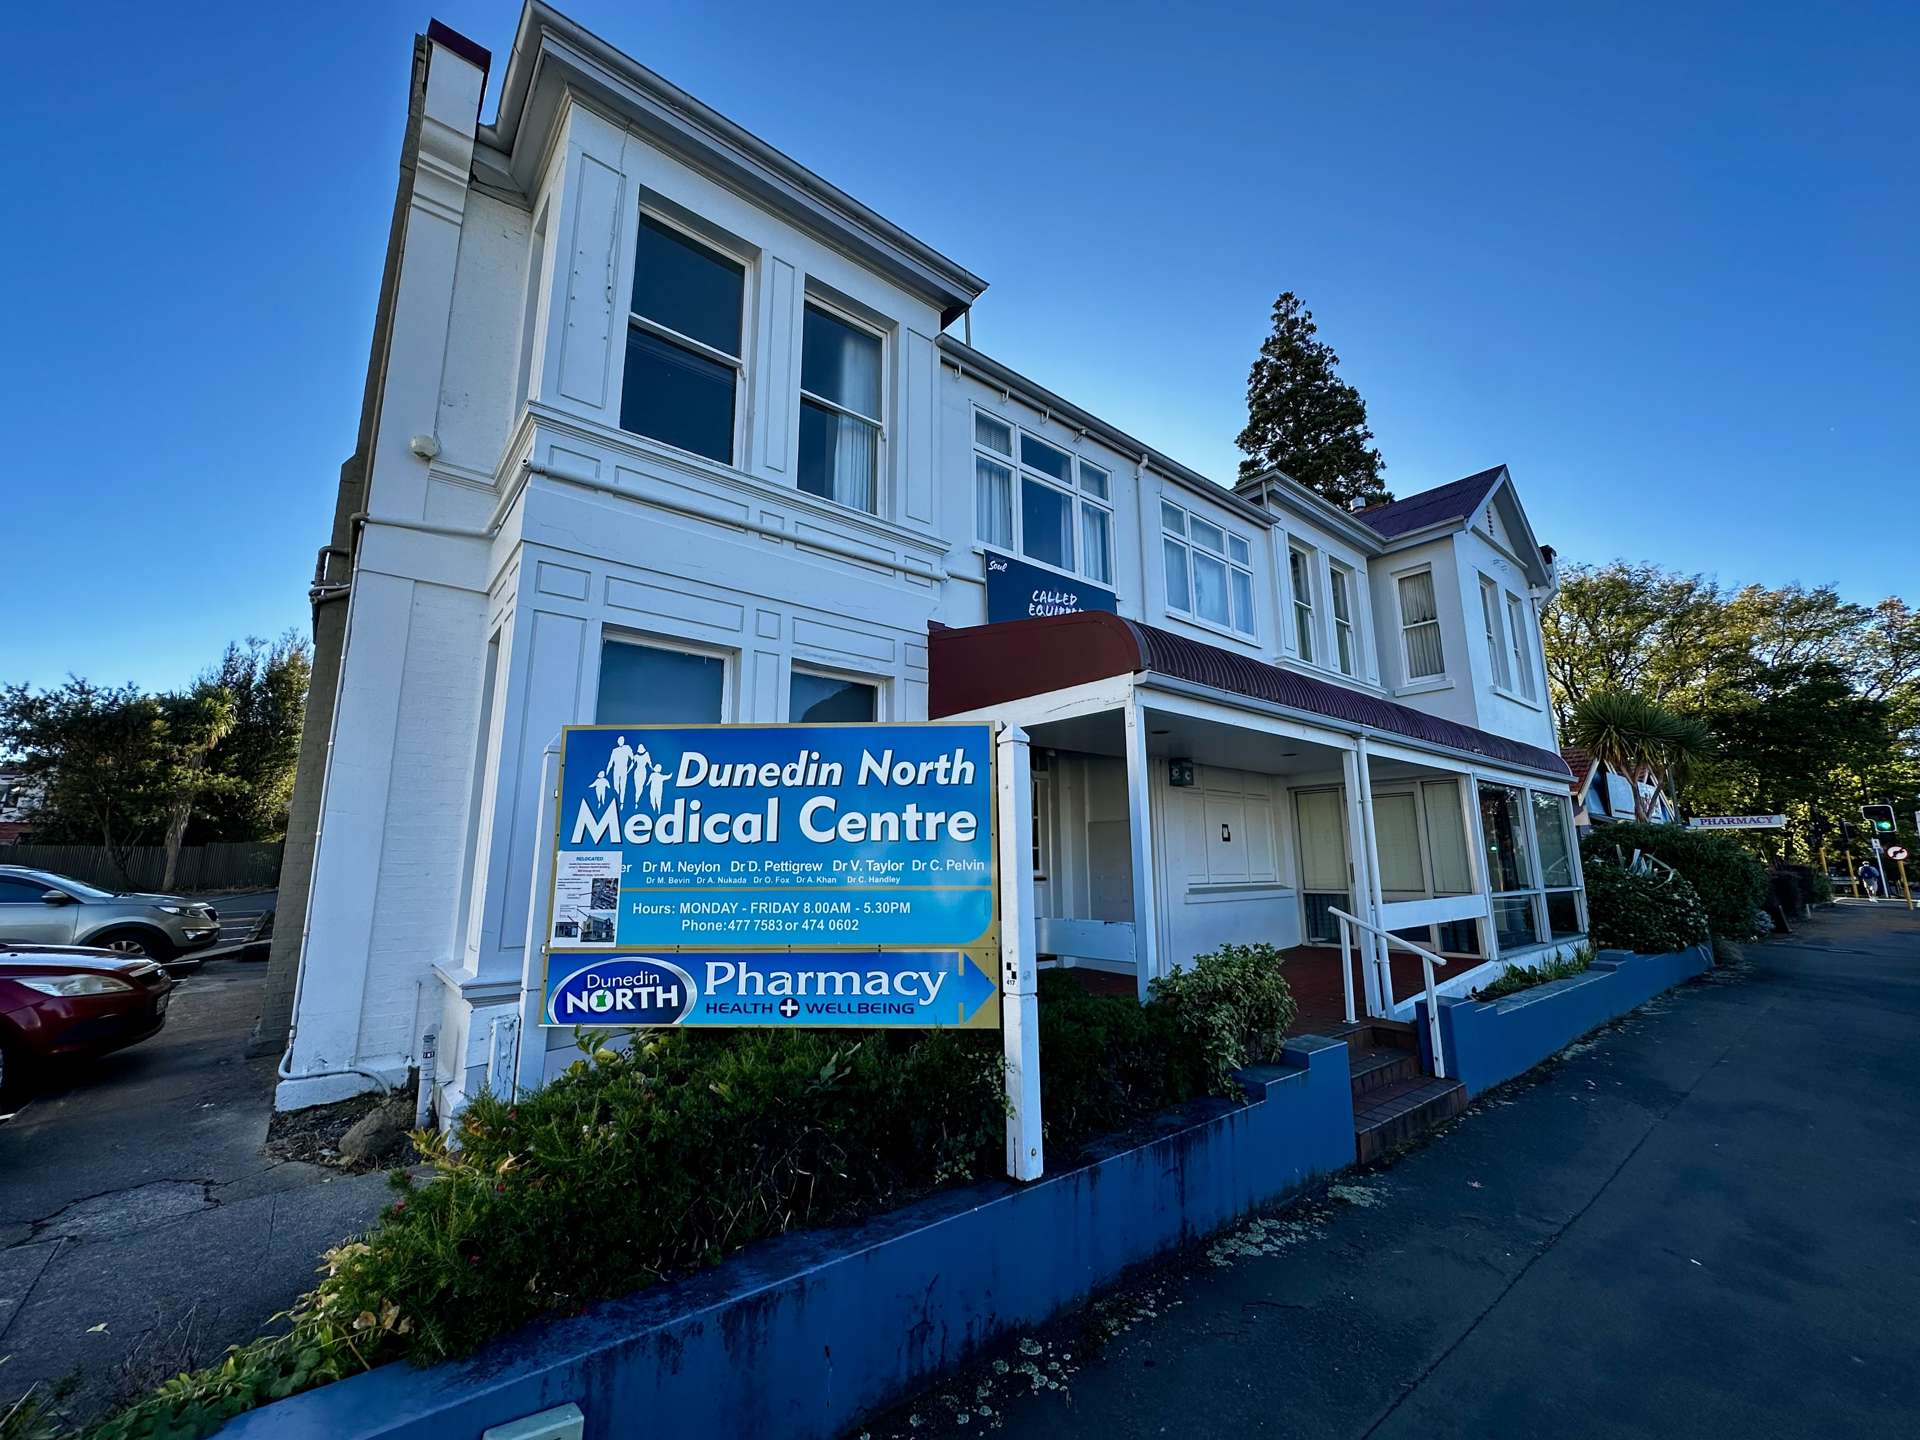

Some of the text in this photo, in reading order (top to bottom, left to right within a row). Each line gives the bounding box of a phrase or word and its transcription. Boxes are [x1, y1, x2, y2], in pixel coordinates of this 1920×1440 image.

[1032, 590, 1077, 605] CALLED
[675, 748, 975, 787] Dunedin North
[570, 796, 977, 845] Medical Centre
[1699, 816, 1773, 825] PHARMACY
[642, 862, 657, 873] Dr
[660, 862, 674, 872] M.
[677, 861, 721, 875] Neylon
[730, 861, 746, 872] Dr
[748, 861, 760, 872] D.
[764, 860, 823, 874] Pettigrew
[832, 860, 848, 872] Dr
[850, 860, 862, 872] V.
[866, 860, 904, 874] Taylor
[912, 860, 927, 871] Dr
[930, 860, 943, 871] C.
[946, 859, 985, 871] Pelvin
[718, 876, 747, 884] Nukada
[753, 876, 763, 884] Dr
[764, 876, 773, 884] O.
[776, 876, 789, 884] Fox
[869, 876, 901, 885] Handley
[632, 903, 675, 915] Hours:
[679, 902, 739, 914] MONDAY
[750, 902, 800, 914] FRIDAY
[803, 902, 851, 914] 8.00AM
[863, 902, 911, 913] 5.30PM
[681, 919, 859, 931] Phone: 477 7583 or 474 0602
[587, 970, 660, 989] Dunedin
[704, 961, 947, 1006] Pharmacy
[566, 985, 678, 1014] NORTH
[706, 1002, 915, 1015] HEALTH WELLBEING
